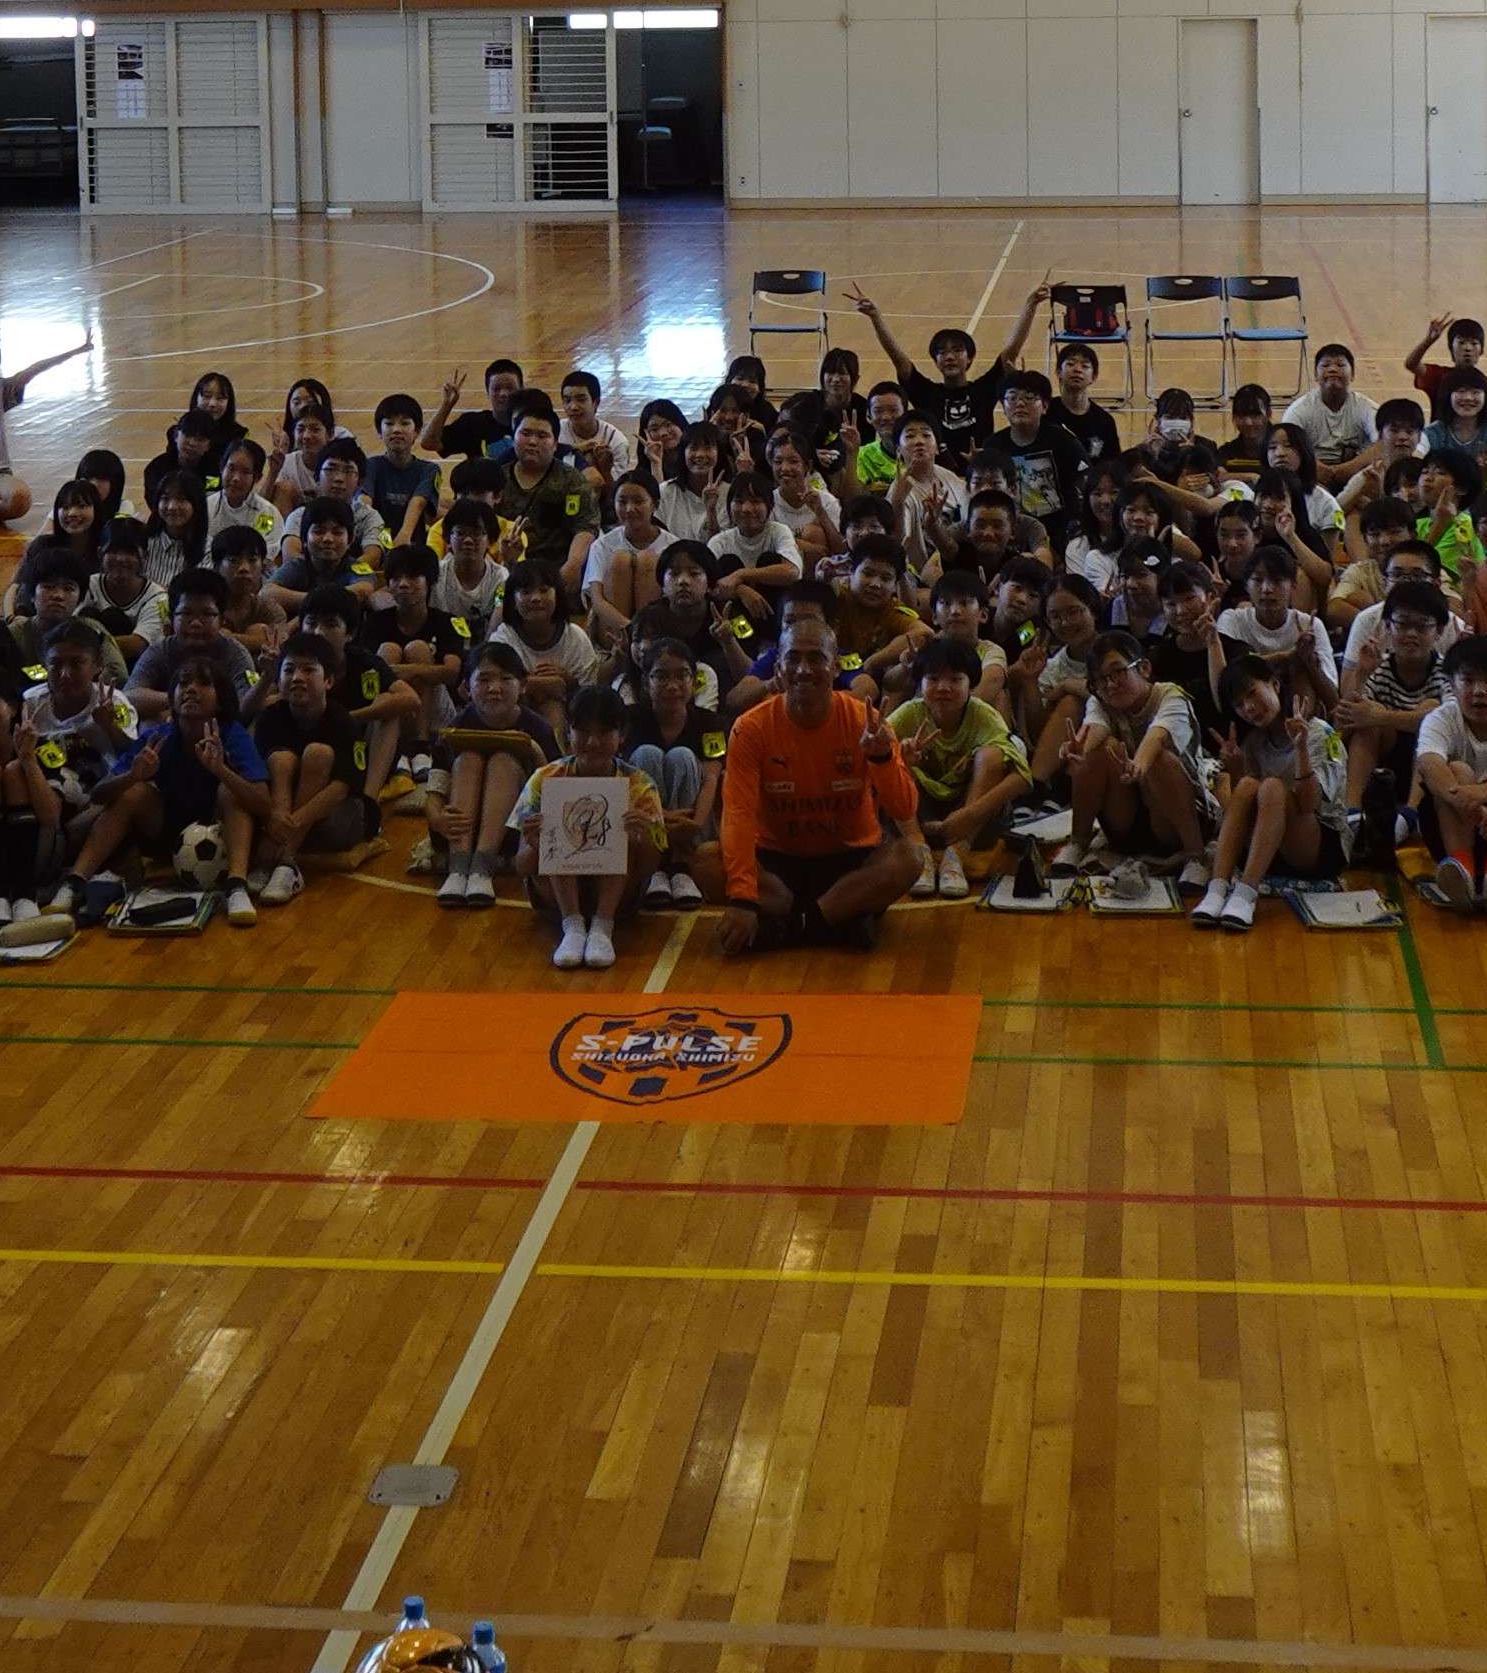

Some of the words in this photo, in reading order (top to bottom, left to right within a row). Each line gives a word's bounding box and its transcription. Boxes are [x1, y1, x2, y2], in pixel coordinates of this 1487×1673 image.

[576, 1034, 763, 1052] S-PULSE
[570, 1051, 667, 1063] SHIZUOKA
[675, 1052, 756, 1063] SHIMIZU
